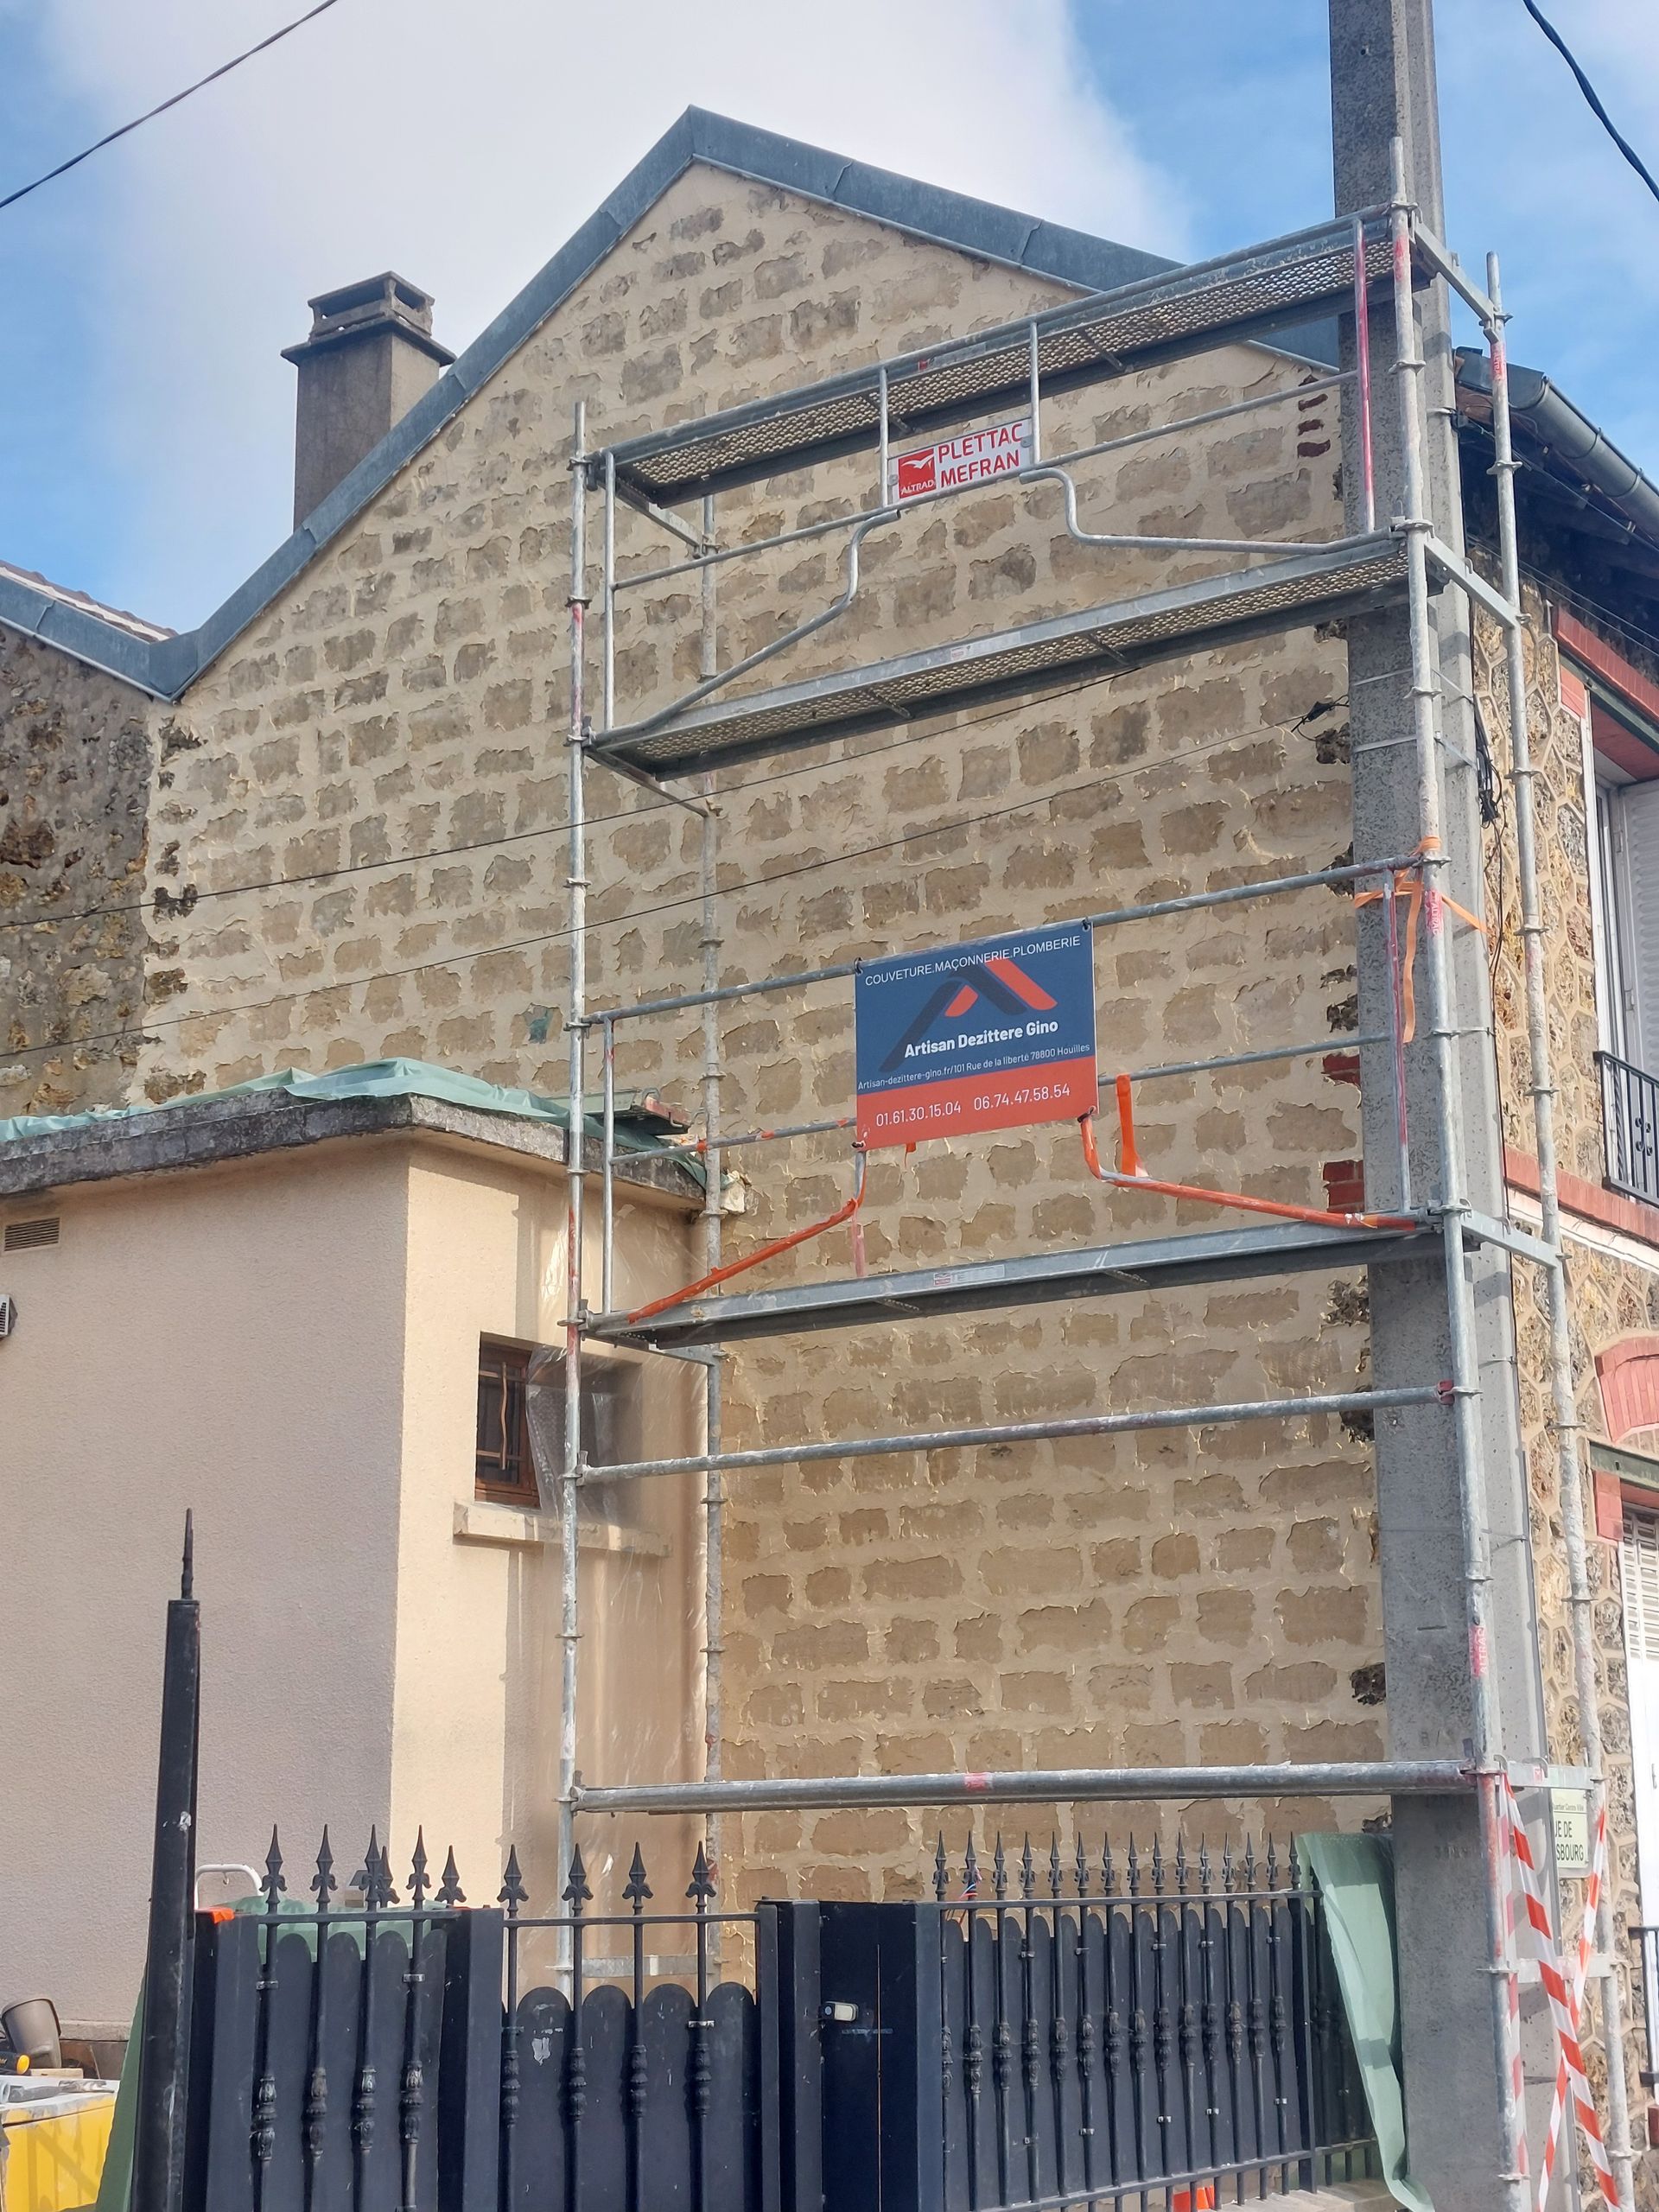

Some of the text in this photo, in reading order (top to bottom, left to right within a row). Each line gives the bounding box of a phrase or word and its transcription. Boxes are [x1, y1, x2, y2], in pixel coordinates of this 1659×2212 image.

[938, 423, 1023, 463] PLETTAC
[941, 449, 1020, 487] MEFRAN
[900, 480, 935, 495] ALTRAD
[905, 1020, 1058, 1058] Artisan Dezittere Gino
[966, 1060, 982, 1071] Rue
[983, 1058, 994, 1068] de
[995, 1057, 1001, 1066] la
[1031, 1048, 1056, 1061] 78800
[1057, 1044, 1090, 1057] Houilles
[876, 1084, 1071, 1127] 01.61.30.15.04 06.74.47.58.54
[1563, 1821, 1573, 1838] DE
[1556, 1843, 1584, 1861] SBOURG
